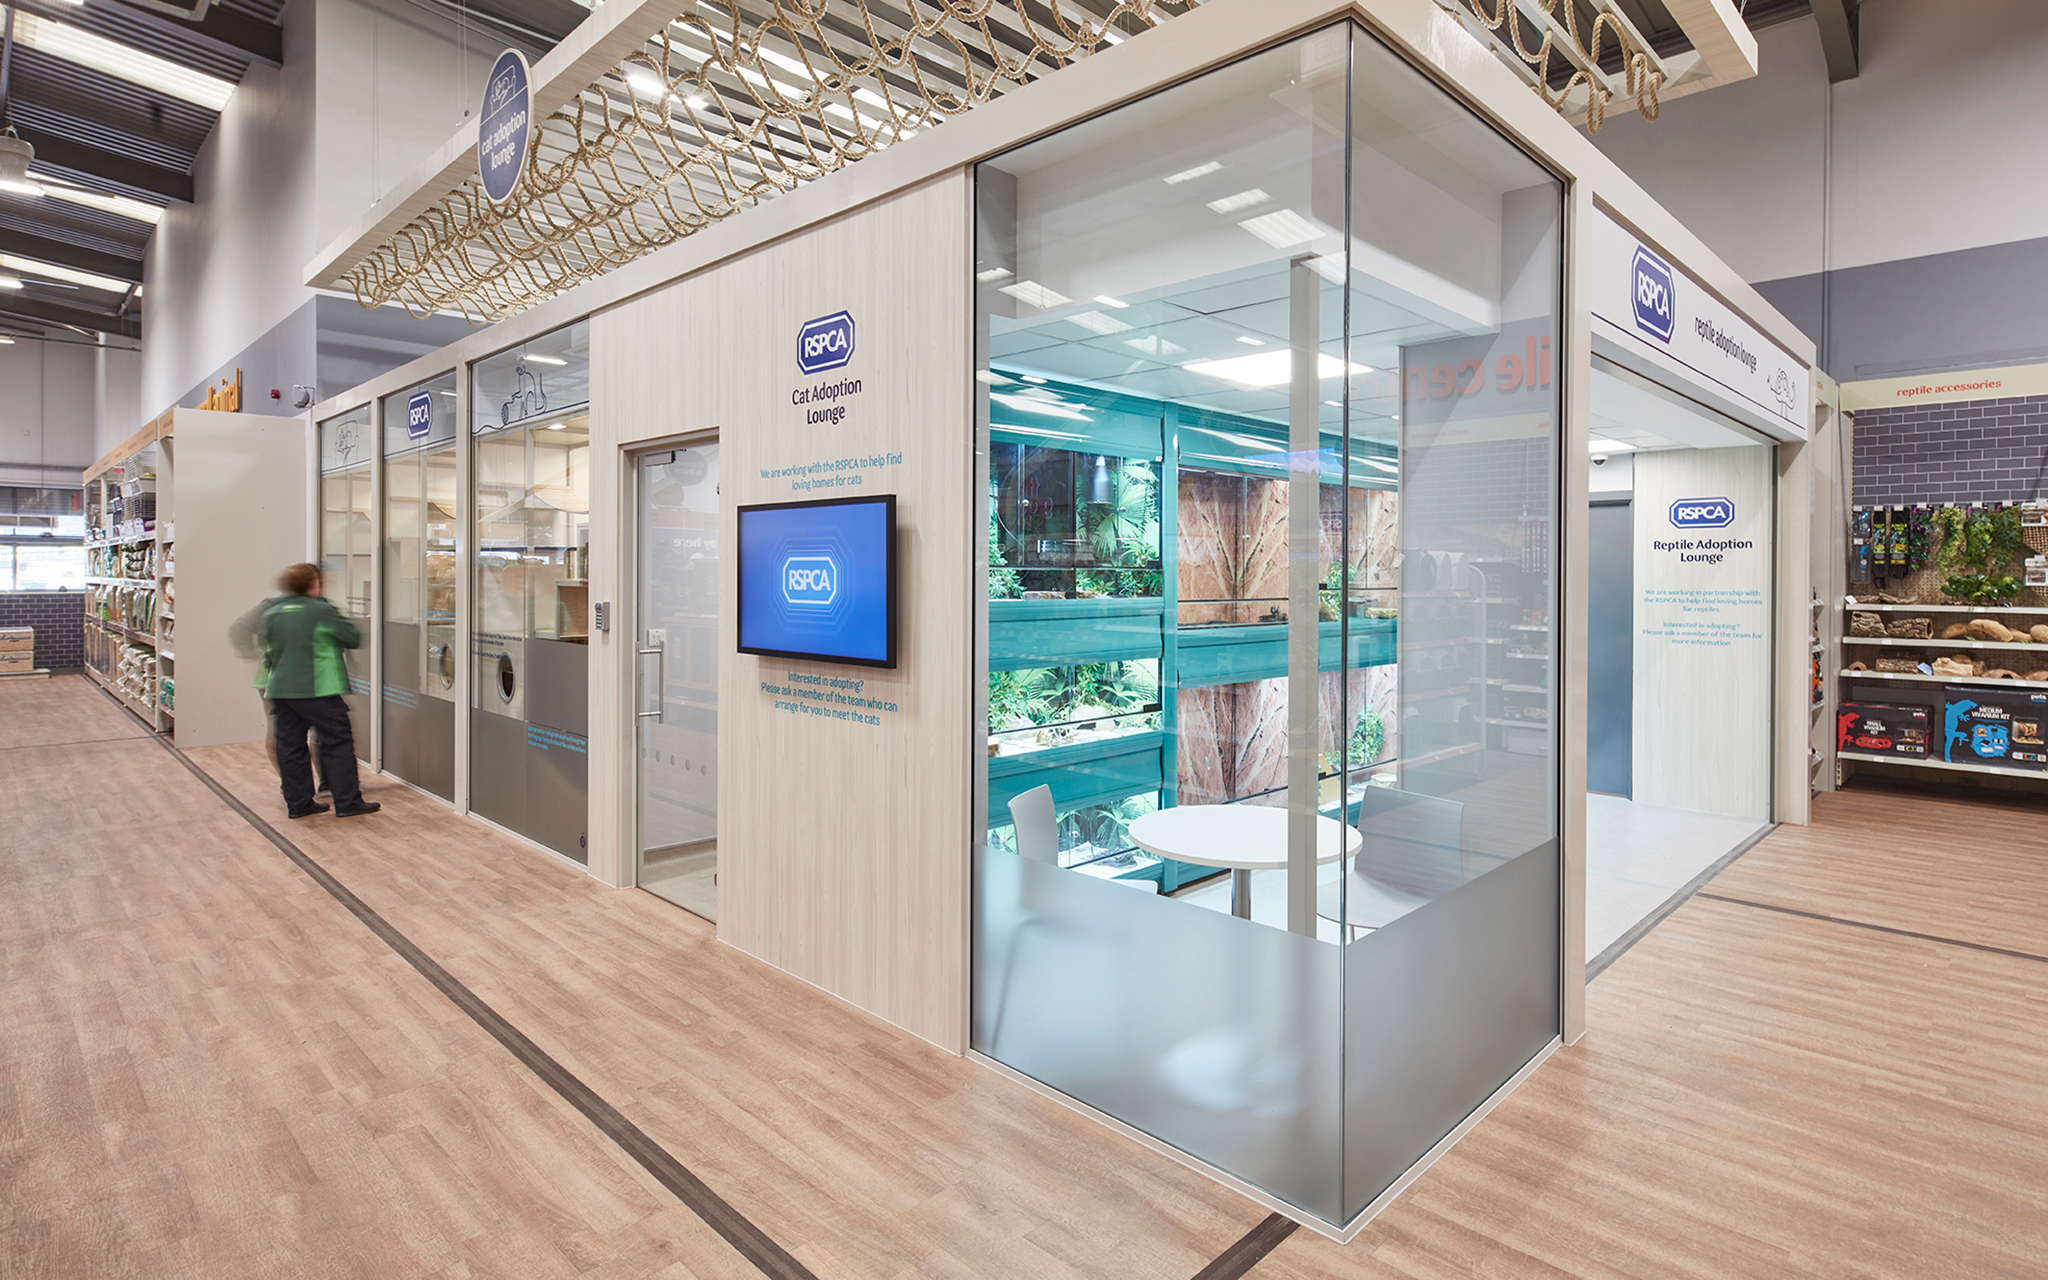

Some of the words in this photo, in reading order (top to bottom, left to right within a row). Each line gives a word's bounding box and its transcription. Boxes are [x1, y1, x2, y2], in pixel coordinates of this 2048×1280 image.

[481, 134, 493, 156] cat
[493, 110, 526, 146] adoption
[491, 141, 516, 170] lounge
[1638, 270, 1670, 320] RSPCA
[805, 328, 847, 358] RSPCA
[1694, 317, 1715, 343] reptile
[1716, 328, 1740, 360] adoption
[1740, 342, 1757, 374] lounge
[792, 388, 810, 405] Cat
[812, 378, 862, 402] Adoption
[1896, 386, 1932, 398] reptile
[1935, 379, 2002, 394] accessories
[410, 404, 429, 426] RSPCA
[807, 406, 845, 425] Lounge
[760, 470, 770, 478] We
[770, 470, 780, 478] are
[782, 465, 806, 477] working
[808, 462, 822, 474] with
[823, 461, 834, 472] the
[835, 458, 859, 470] RSPCA
[860, 458, 868, 468] to
[869, 454, 885, 469] help
[886, 452, 902, 465] find
[792, 480, 811, 492] loving
[812, 478, 834, 488] homes
[836, 475, 846, 486] for
[847, 475, 862, 485] cats
[1678, 506, 1726, 520] RSPCA
[1653, 539, 1694, 552] Reptile
[1696, 539, 1753, 551] Adoption
[1680, 552, 1723, 564] Lounge
[789, 569, 831, 591] RSPCA
[1686, 597, 1701, 605] help
[1717, 598, 1738, 606] loving
[1694, 606, 1720, 614] reptiles
[1706, 622, 1740, 630] adopting?
[1690, 638, 1730, 646] information
[788, 671, 821, 685] Interested
[822, 675, 828, 686] in
[830, 676, 864, 693] adopting?
[761, 682, 780, 695] Please
[781, 685, 792, 696] ask
[793, 688, 797, 697] a
[798, 689, 825, 701] member
[826, 691, 834, 702] of
[835, 693, 846, 705] the
[848, 695, 866, 707] team
[867, 697, 882, 710] who
[884, 702, 898, 712] can
[774, 700, 798, 714] arrange
[800, 702, 810, 713] for
[810, 706, 822, 717] you
[824, 707, 832, 717] to
[832, 708, 850, 721] meet
[851, 710, 863, 723] the
[864, 715, 880, 726] cats
